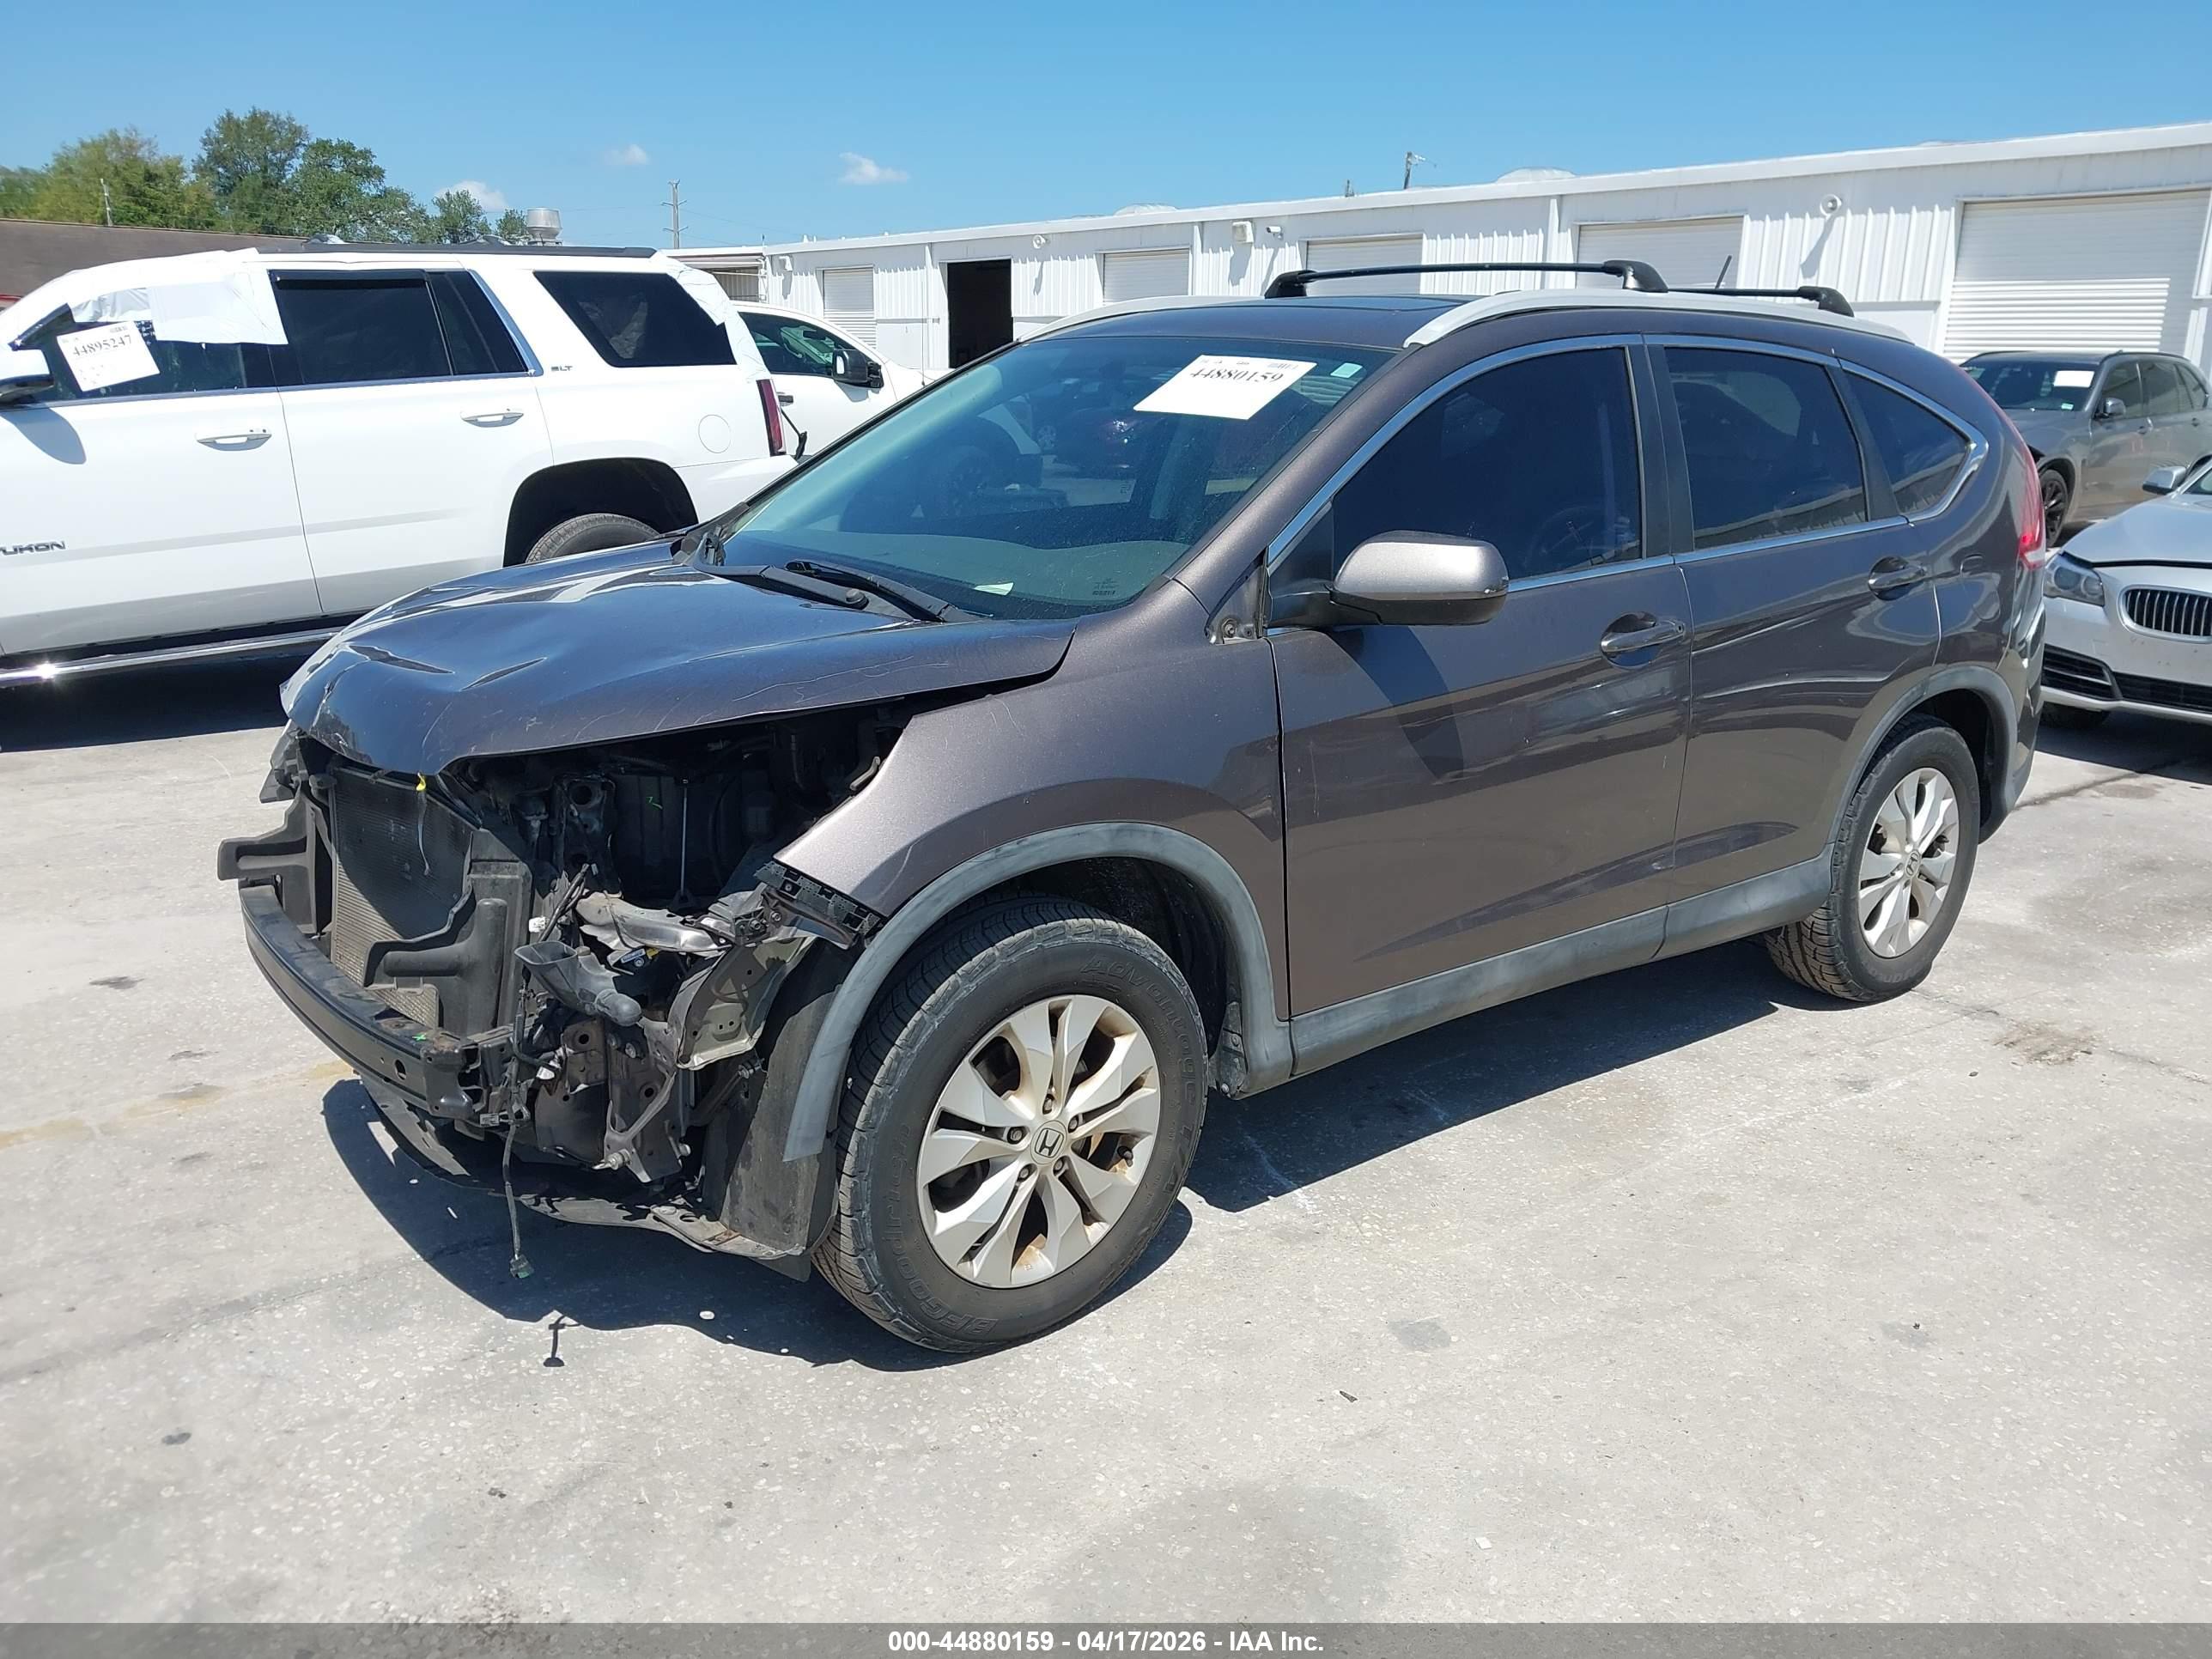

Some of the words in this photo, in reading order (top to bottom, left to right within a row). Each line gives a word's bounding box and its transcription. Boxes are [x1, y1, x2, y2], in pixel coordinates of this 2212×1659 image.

[72, 334, 131, 356] 44895247
[1190, 368, 1285, 383] 44880159
[0, 541, 66, 556] UKON
